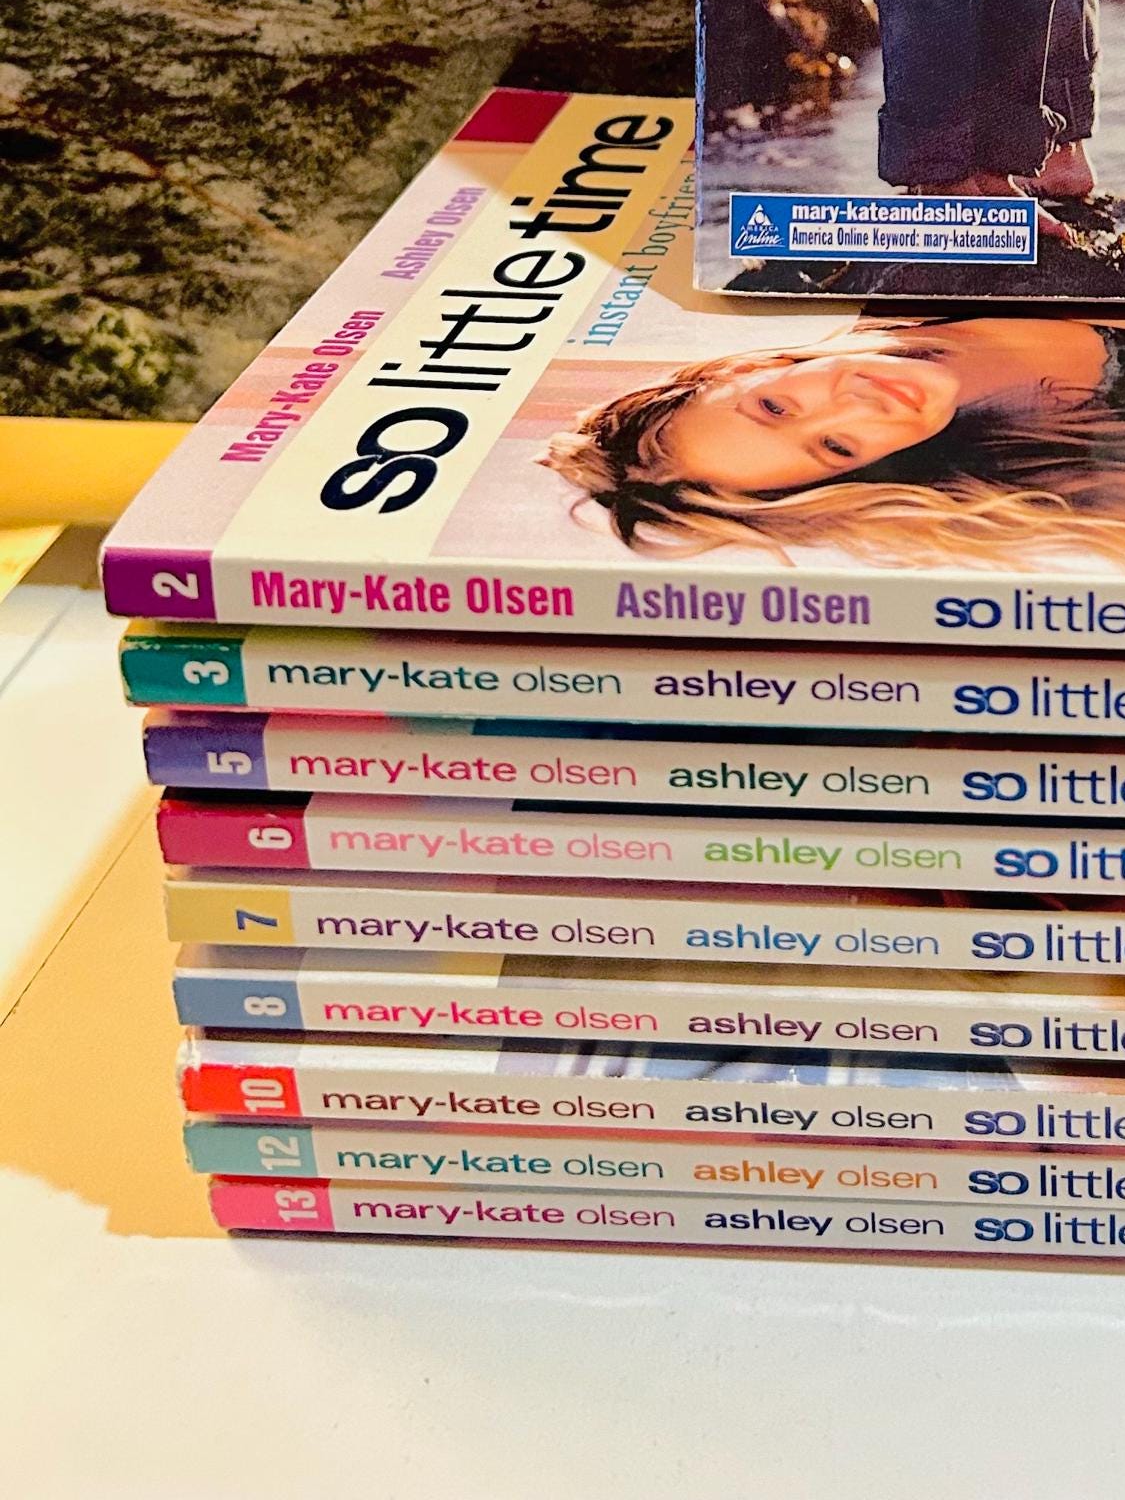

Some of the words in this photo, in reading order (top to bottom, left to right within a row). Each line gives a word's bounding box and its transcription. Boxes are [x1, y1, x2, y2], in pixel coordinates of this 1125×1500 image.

[510, 114, 675, 240] time
[380, 224, 455, 280] Ashley
[426, 186, 488, 227] Olsen
[792, 202, 1028, 225] mary-kateandashley.com
[791, 227, 834, 247] America
[837, 228, 869, 246] Online
[872, 228, 920, 248] Keyword:
[923, 229, 1028, 250] mary-kateandashley
[368, 249, 586, 391] little
[566, 264, 658, 347] instant
[220, 356, 339, 462] Mary-Kate
[313, 309, 386, 357] Olsen
[320, 406, 469, 514] so
[152, 571, 199, 599] 2
[251, 570, 451, 615] Mary-Kate
[466, 577, 574, 617] Olsen
[617, 580, 746, 627] Ashley
[761, 585, 870, 626] Olsen
[935, 595, 1001, 628] so
[183, 659, 231, 686] 3
[268, 661, 499, 693] mary-kate
[513, 666, 621, 694] olsen
[654, 669, 796, 705] ashley
[810, 672, 920, 703] olsen
[953, 683, 1020, 716] so
[208, 750, 253, 775] 5
[290, 752, 517, 783] mary-kate
[530, 758, 637, 786] olsen
[668, 762, 808, 796] ashley
[822, 765, 929, 795] olsen
[962, 768, 1027, 801] so
[248, 827, 293, 850] 6
[330, 827, 555, 859] mary-kate
[567, 832, 672, 862] olsen
[704, 836, 842, 870] ashley
[855, 840, 961, 870] olsen
[993, 847, 1058, 878] so
[236, 909, 278, 930] 7
[317, 913, 538, 944] mary-kate
[551, 919, 655, 947] olsen
[686, 923, 821, 957] ashley
[835, 927, 940, 956] olsen
[971, 930, 1035, 960] so
[243, 996, 287, 1017] 8
[324, 999, 544, 1029] mary-kate
[555, 1005, 658, 1031] olsen
[688, 1010, 822, 1043] ashley
[835, 1014, 938, 1042] olsen
[969, 1020, 1032, 1049] so
[241, 1078, 284, 1112] 10
[323, 1091, 541, 1117] mary-kate
[553, 1096, 655, 1120] olsen
[685, 1099, 818, 1131] ashley
[831, 1104, 933, 1131] olsen
[964, 1109, 1026, 1136] so
[257, 1136, 300, 1170] 12
[337, 1147, 551, 1175] mary-kate
[563, 1152, 664, 1179] olsen
[693, 1159, 825, 1190] ashley
[837, 1161, 938, 1190] olsen
[968, 1168, 1030, 1195] so
[275, 1190, 317, 1223] 13
[353, 1198, 565, 1224] mary-kate
[577, 1204, 675, 1227] olsen
[704, 1208, 832, 1237] ashley
[845, 1211, 944, 1237] olsen
[974, 1216, 1034, 1243] so
